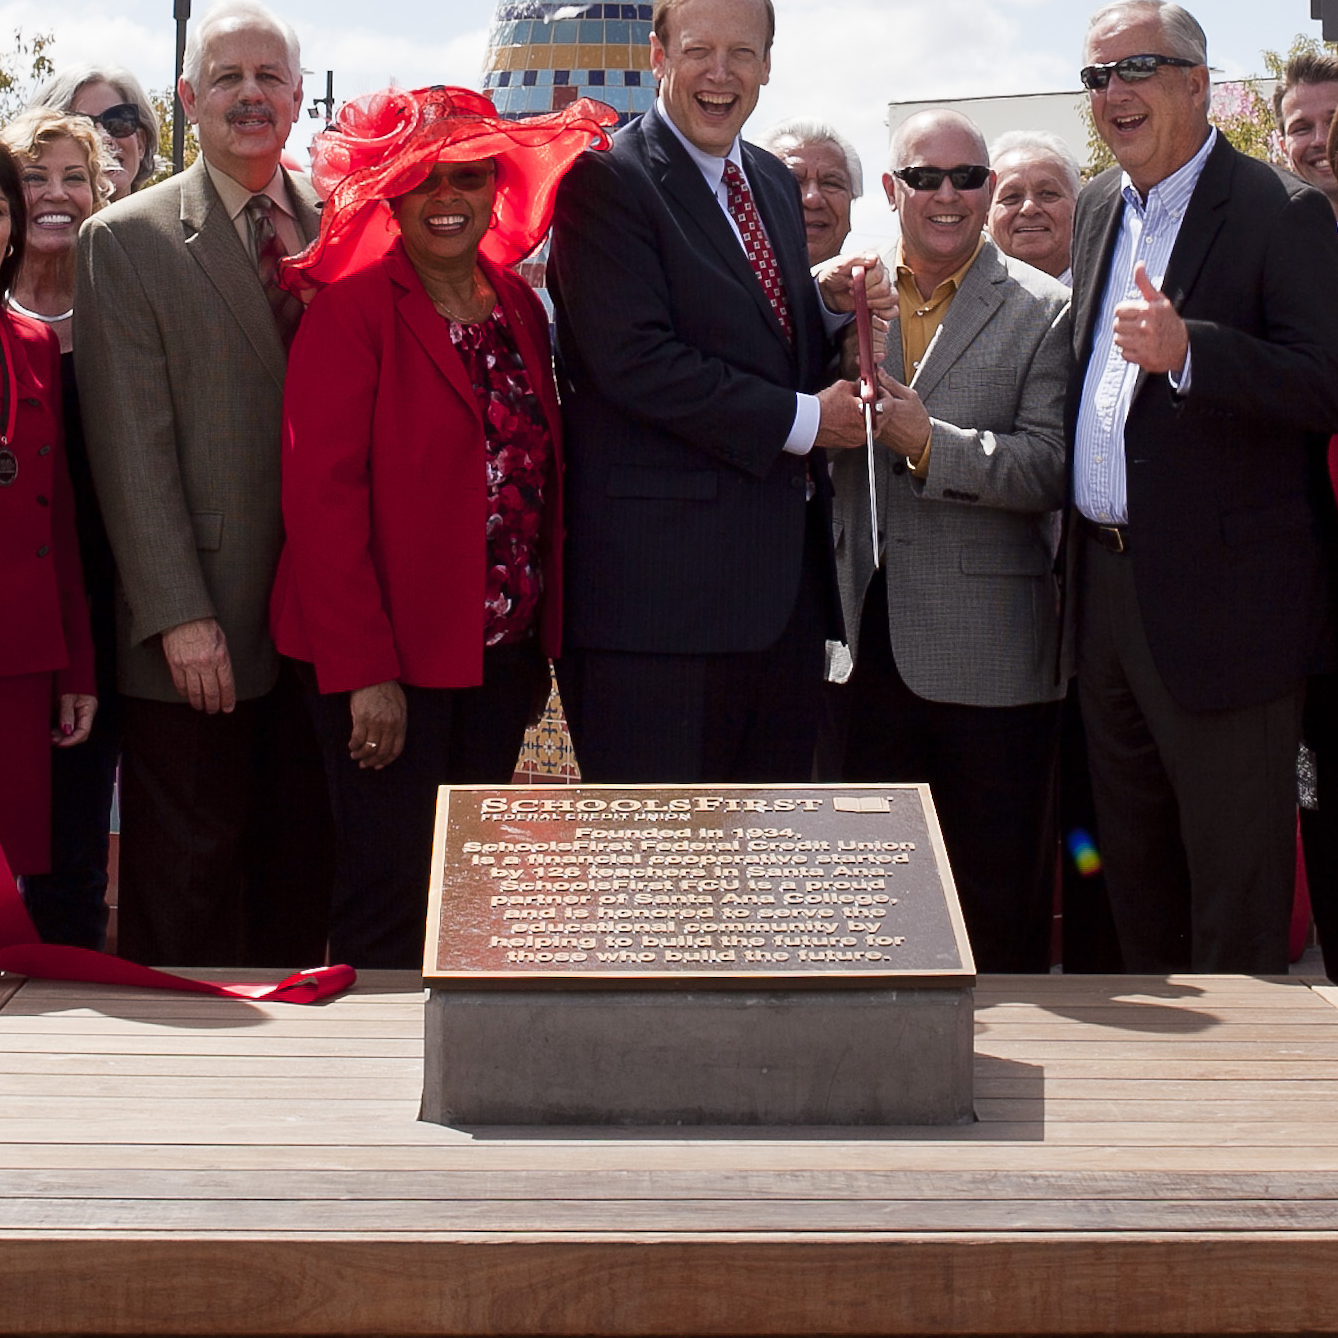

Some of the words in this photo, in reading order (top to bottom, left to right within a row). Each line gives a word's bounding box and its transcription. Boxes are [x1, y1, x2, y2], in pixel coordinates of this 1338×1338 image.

[481, 813, 561, 821] FEDERAL
[565, 813, 629, 821] CREDIT
[634, 813, 692, 821] UNION
[575, 828, 691, 839] Founded
[699, 828, 723, 838] in
[733, 828, 801, 839] 1934,
[462, 841, 633, 852] SchoolsFirst
[641, 841, 739, 852] Federal
[748, 841, 829, 851] Credit
[838, 841, 915, 851] Union
[472, 854, 495, 865] is
[502, 856, 520, 865] a
[527, 854, 641, 864] financial
[649, 854, 808, 867] cooperative
[816, 853, 909, 864] started
[490, 867, 523, 880] by
[532, 867, 581, 877] 126
[587, 867, 706, 878] teachers
[714, 867, 738, 877] in
[747, 867, 824, 877] Santa
[832, 867, 893, 877] Ana.
[500, 880, 674, 892] SchoolsFirst
[681, 880, 739, 891] FCU
[748, 880, 772, 890] is
[780, 882, 796, 890] a
[806, 880, 886, 892] proud
[491, 895, 591, 906] partner
[599, 894, 628, 905] of
[634, 894, 713, 905] Santa
[720, 894, 775, 904] Ana
[783, 893, 899, 905] College,
[504, 908, 556, 919] and
[565, 908, 589, 918] is
[598, 908, 713, 918] honored
[721, 908, 750, 918] to
[757, 908, 834, 918] serve
[842, 908, 886, 918] the
[512, 922, 675, 933] educational
[684, 921, 839, 934] community
[847, 921, 881, 933] by
[490, 936, 596, 949] helping
[604, 936, 633, 947] to
[642, 936, 712, 947] build
[721, 936, 766, 946] the
[773, 935, 857, 946] future
[864, 935, 905, 946] for
[506, 951, 588, 962] those
[596, 951, 656, 962] who
[665, 950, 736, 962] build
[744, 950, 789, 962] the
[797, 950, 891, 962] future.
